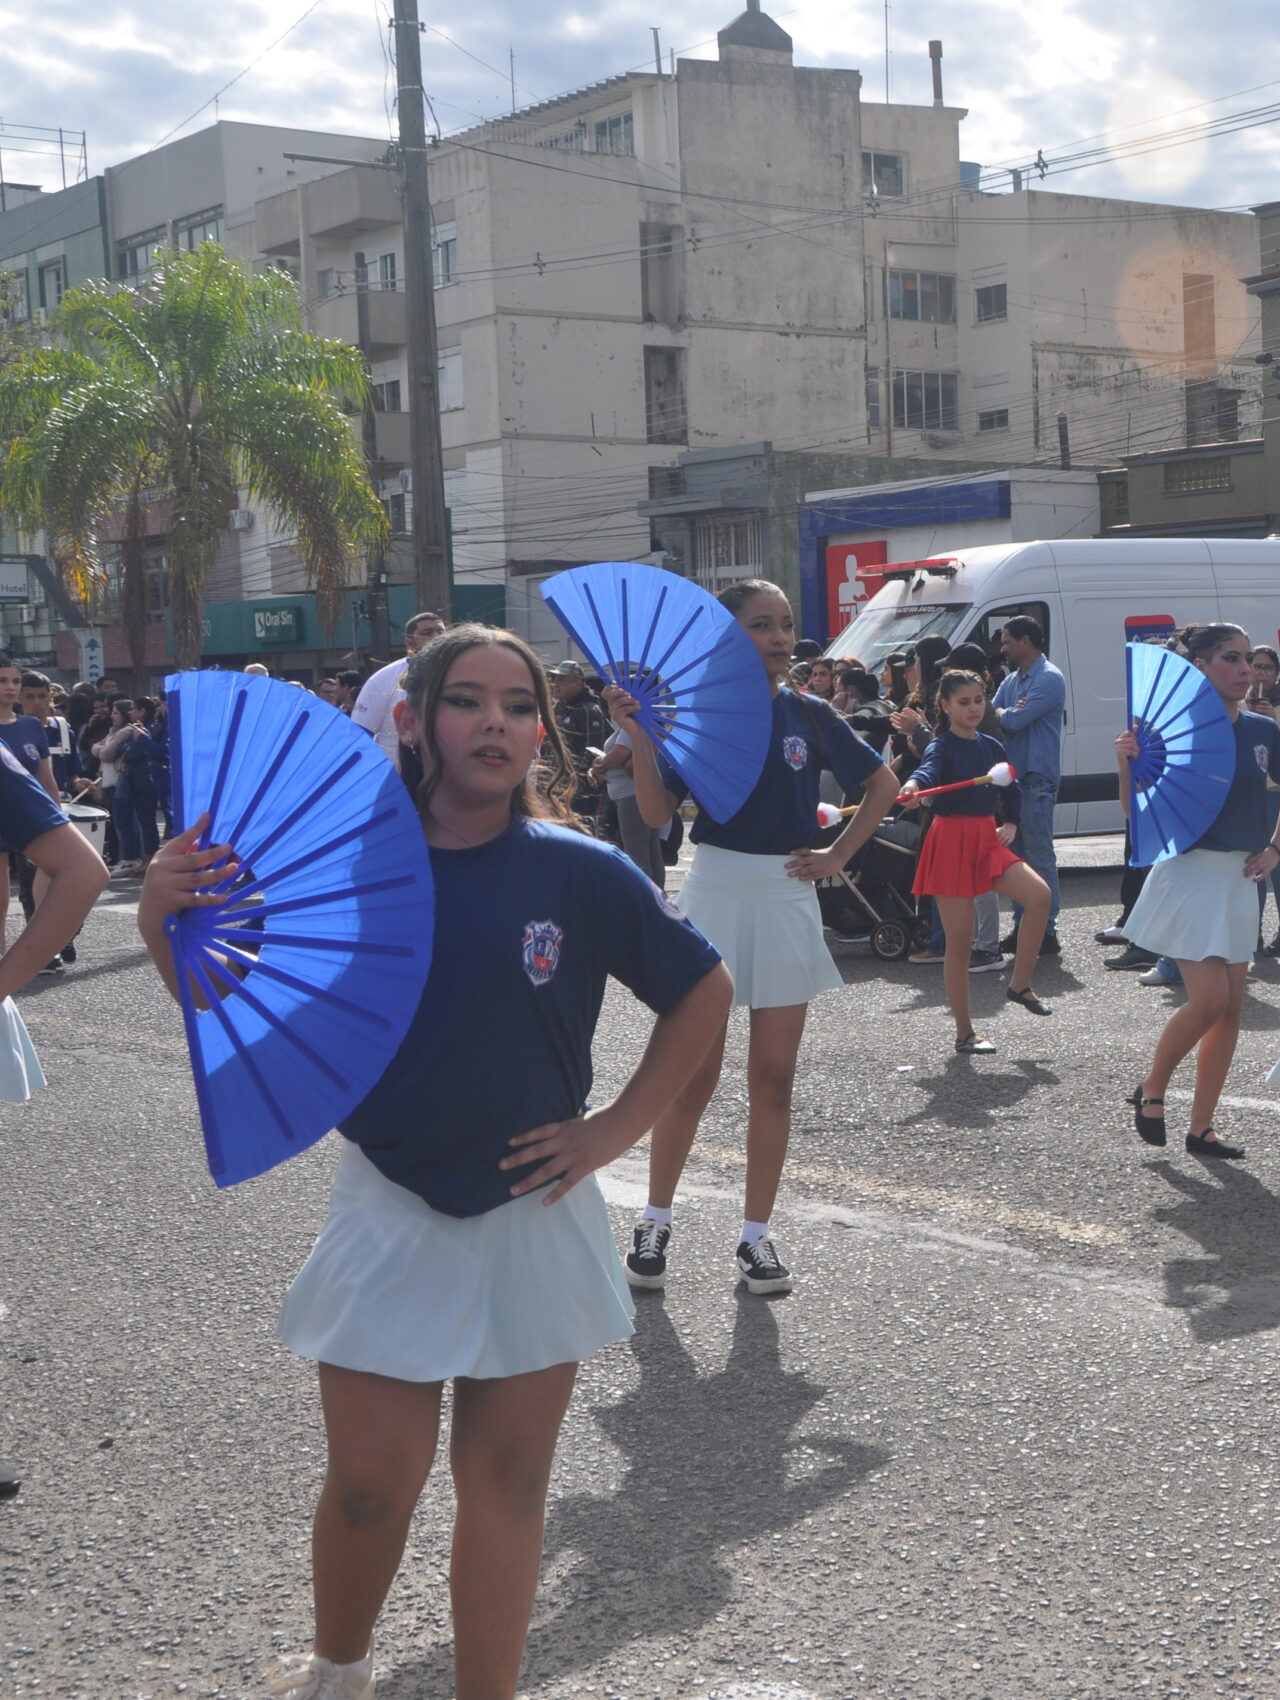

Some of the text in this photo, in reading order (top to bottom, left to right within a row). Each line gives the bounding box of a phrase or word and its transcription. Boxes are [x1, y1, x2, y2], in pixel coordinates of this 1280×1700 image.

[1, 584, 26, 593] Hotel
[265, 610, 293, 627] Oral Sin
